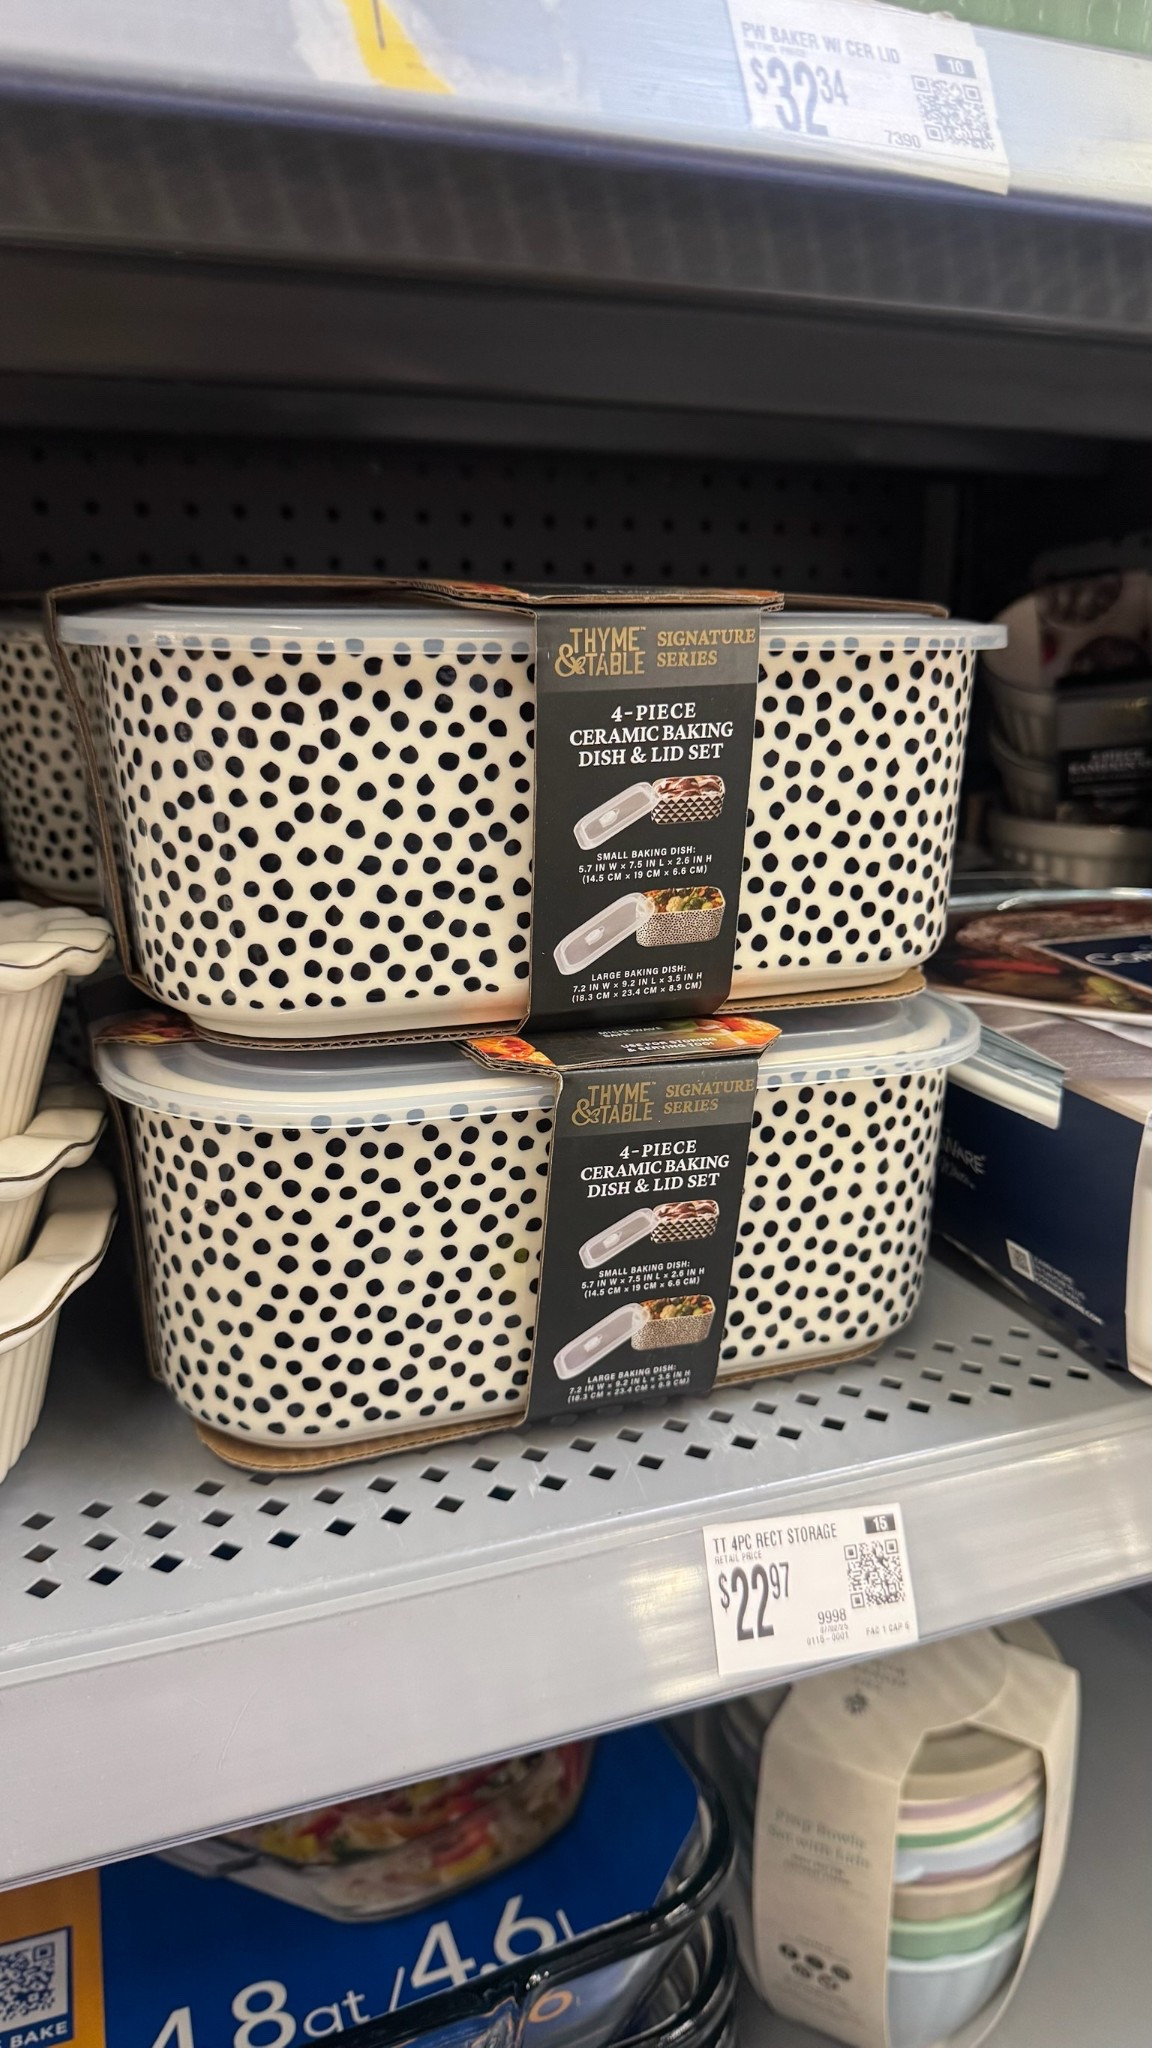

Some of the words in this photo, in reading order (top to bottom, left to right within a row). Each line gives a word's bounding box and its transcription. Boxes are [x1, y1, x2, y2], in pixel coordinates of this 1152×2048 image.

[742, 22, 765, 40] PW
[770, 26, 819, 49] BAKER
[845, 39, 874, 60] CER
[877, 46, 900, 64] LID
[946, 59, 965, 74] 10
[884, 129, 921, 148] 7390
[657, 628, 756, 647] SIGNATURE
[656, 650, 718, 667] SERIES
[611, 702, 697, 722] 4-PIECE
[569, 725, 658, 745] CERAMIC
[662, 721, 733, 740] BAKING
[578, 749, 626, 766] DISH
[630, 746, 646, 763] &
[651, 746, 683, 762] LID
[688, 743, 723, 760] SET
[597, 851, 628, 861] SMALL
[631, 848, 666, 858] BAKING
[670, 845, 695, 855] DISH:
[579, 864, 592, 873] 5.7
[595, 863, 605, 871] IN
[609, 862, 617, 870] W
[629, 860, 642, 869] 7.5
[646, 859, 655, 867] IN
[676, 856, 689, 865] 2.6
[693, 855, 702, 863] IN
[706, 854, 711, 862] H
[582, 874, 603, 884] (14.5
[607, 872, 621, 881] CM
[634, 870, 643, 878] 19
[646, 869, 660, 877] CM
[672, 867, 686, 875] 6.6
[689, 864, 707, 874] CM)
[589, 983, 598, 991] IN
[622, 979, 635, 987] 9.2
[667, 974, 680, 982] 3.5
[591, 971, 621, 981] LARGE
[624, 967, 658, 977] BAKING
[662, 965, 686, 975] DISH:
[572, 993, 592, 1003] (18.3
[596, 991, 609, 999] CM
[622, 988, 640, 996] 23.4
[643, 986, 657, 994] CM
[668, 983, 682, 991] 8.9
[685, 980, 701, 990] CM)
[638, 1043, 687, 1051] SERVING
[669, 1037, 717, 1045] STORING
[665, 1079, 754, 1098] SIGNATURE
[663, 1098, 719, 1115] SERIES
[619, 1139, 697, 1159] 4-PIECE
[580, 1160, 661, 1180] CERAMIC
[664, 1154, 730, 1174] BAKING
[587, 1181, 630, 1198] DISH
[634, 1178, 648, 1193] &
[653, 1176, 683, 1191] LID
[687, 1172, 719, 1188] SET
[581, 1281, 594, 1289] 5.7
[597, 1279, 606, 1287] IN
[628, 1275, 640, 1283] 7.5
[643, 1273, 653, 1281] IN
[672, 1269, 684, 1278] 2.6
[686, 1268, 696, 1276] IN
[698, 1267, 705, 1275] H
[598, 1267, 627, 1277] SMALL
[631, 1263, 663, 1273] BAKING
[666, 1260, 690, 1270] DISH:
[584, 1288, 604, 1298] (14.5
[607, 1286, 620, 1294] CM
[643, 1282, 656, 1290] CM
[667, 1279, 680, 1287] 6.6
[683, 1276, 699, 1285] CM)
[587, 1373, 615, 1383] LARGE
[618, 1368, 650, 1379] BAKING
[653, 1364, 677, 1374] DISH:
[872, 1516, 888, 1531] 15
[713, 1537, 725, 1553] TT
[731, 1533, 751, 1551] 4PC
[755, 1530, 782, 1548] RECT
[787, 1523, 836, 1544] STORAGE
[714, 1554, 739, 1564] RETAIL
[741, 1551, 761, 1561] PRICE
[818, 1608, 847, 1625] 9998
[10, 2020, 69, 2048] BAKE
